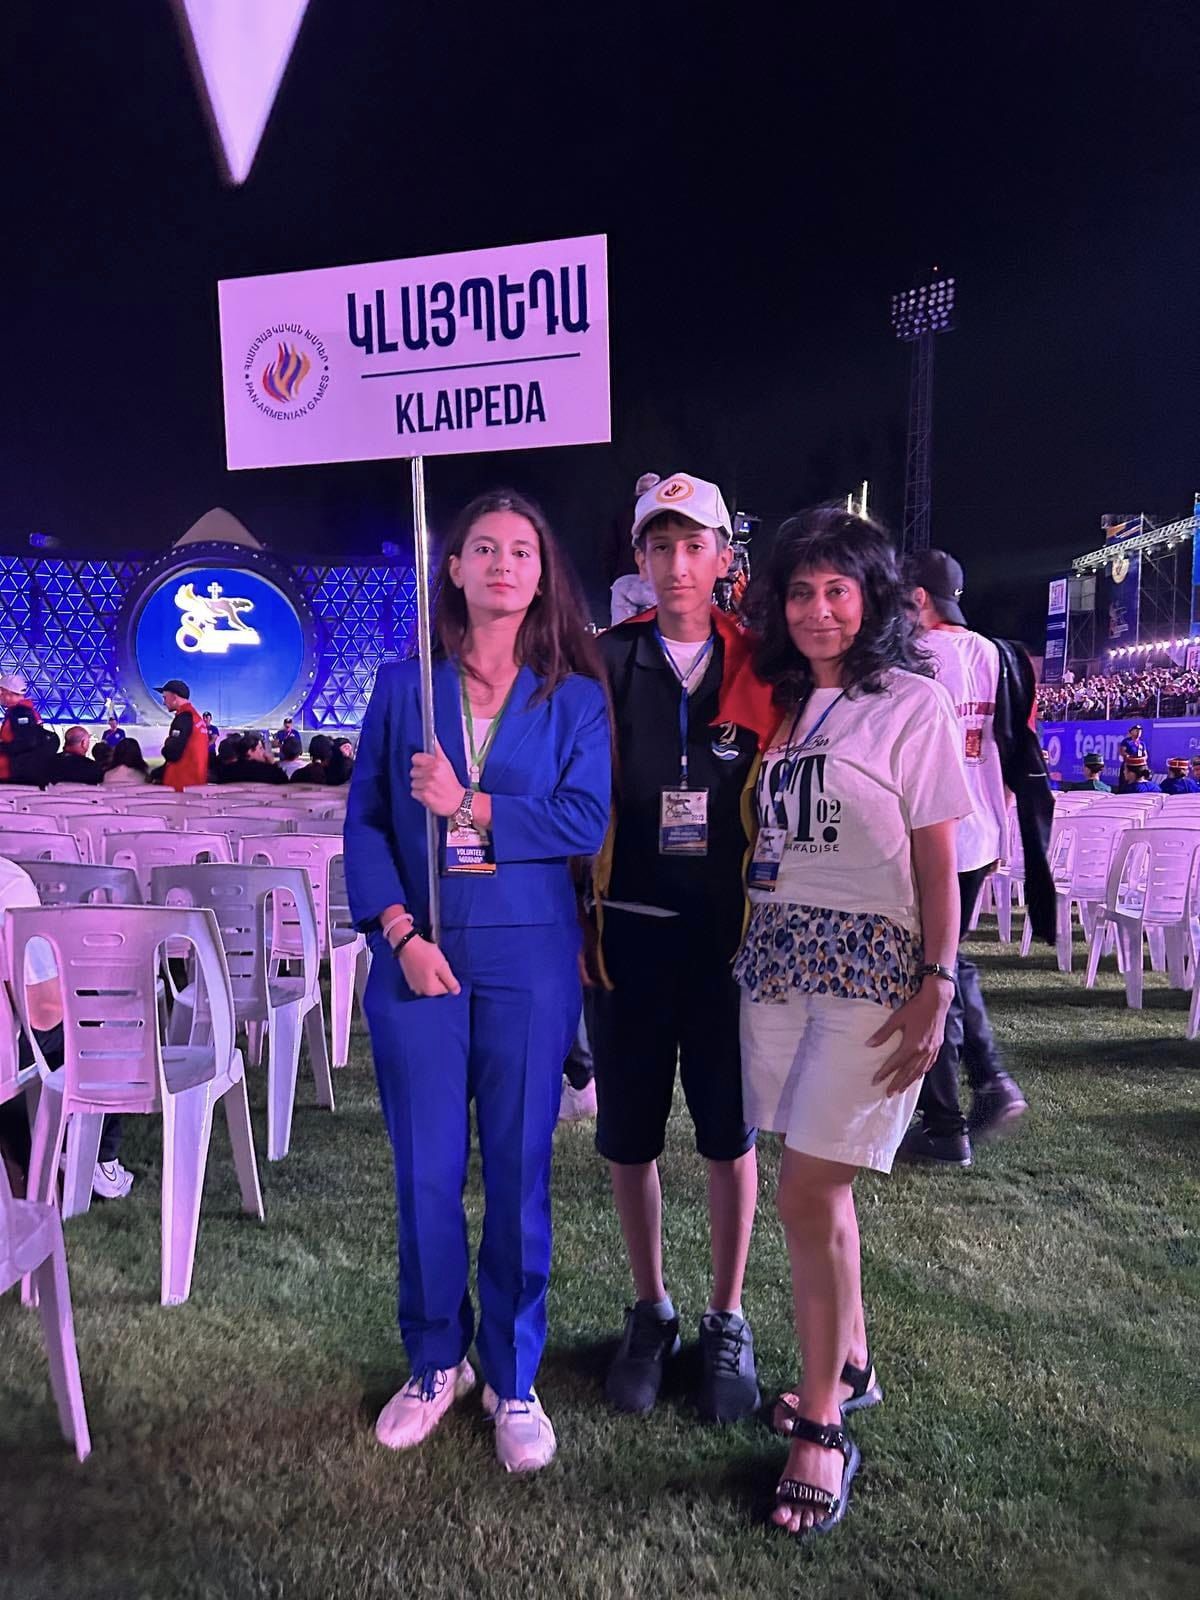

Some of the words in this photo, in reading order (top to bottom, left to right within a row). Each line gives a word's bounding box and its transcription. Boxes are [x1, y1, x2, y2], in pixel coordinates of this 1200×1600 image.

[347, 264, 591, 354] ԿԼԱՅՊԵԴԱ
[245, 382, 308, 420] PAN-ARMENIAN
[307, 375, 330, 410] GAMES
[395, 381, 546, 434] KLAIPEDA
[817, 799, 841, 823] 02
